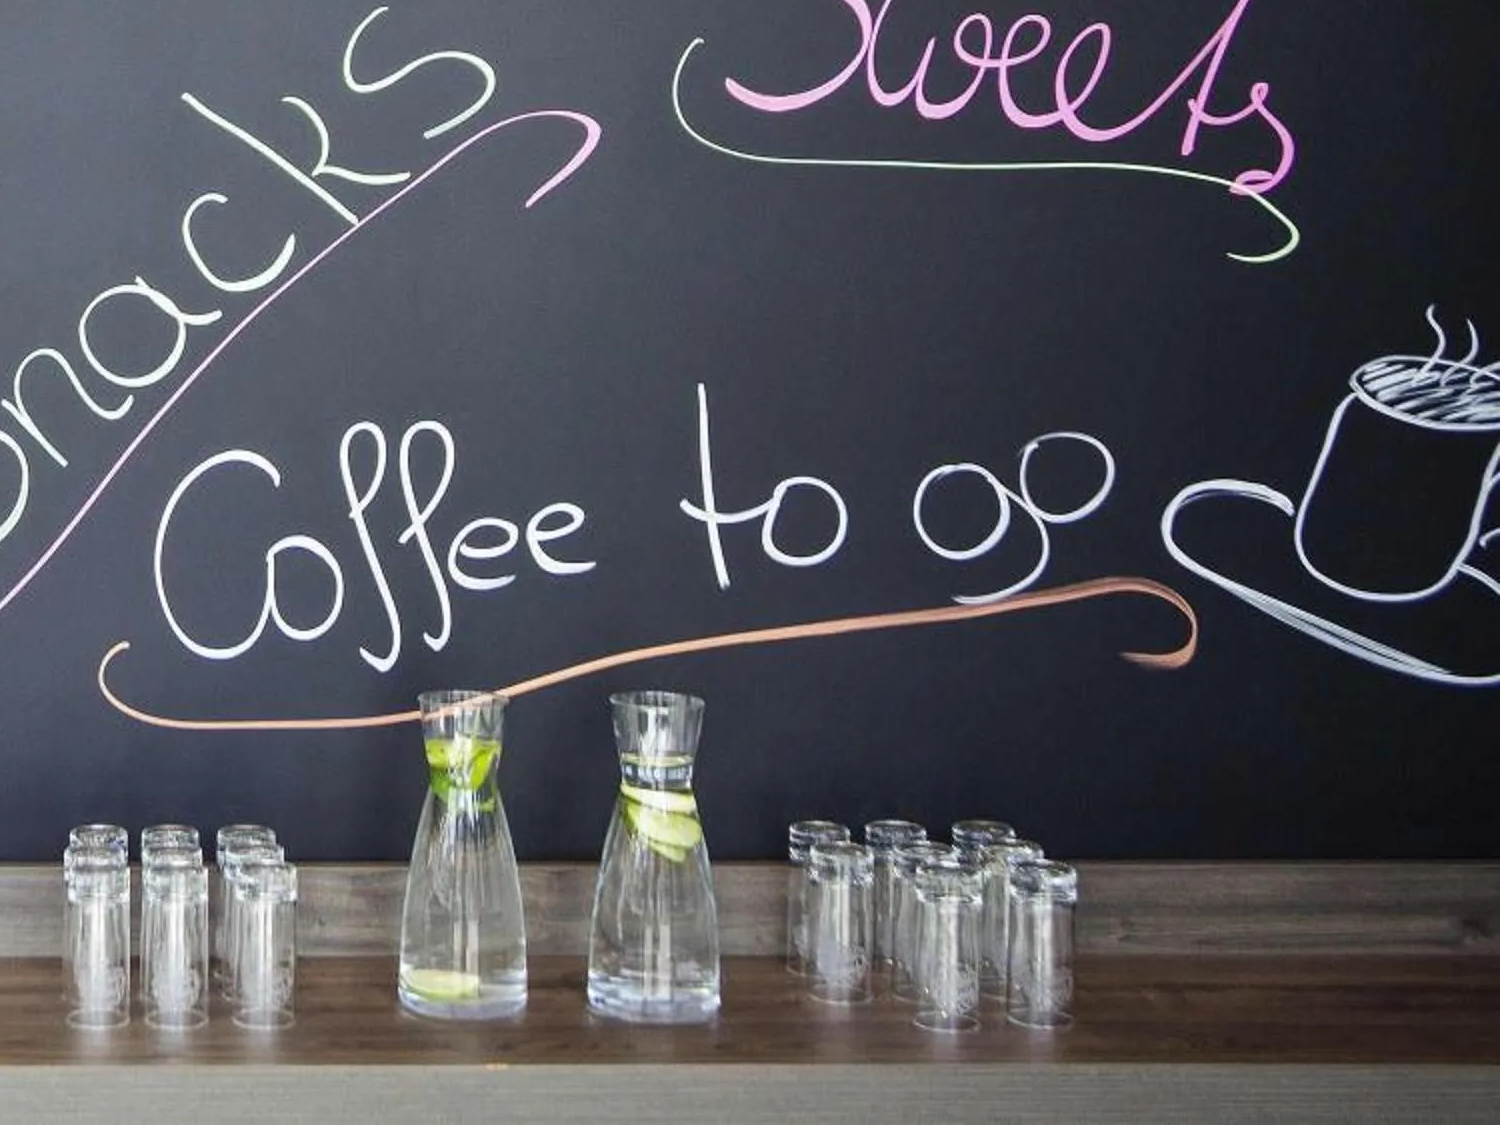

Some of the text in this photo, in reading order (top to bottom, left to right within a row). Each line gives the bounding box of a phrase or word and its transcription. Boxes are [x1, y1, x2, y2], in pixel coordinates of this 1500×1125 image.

[154, 381, 1117, 674] Coffee to go
